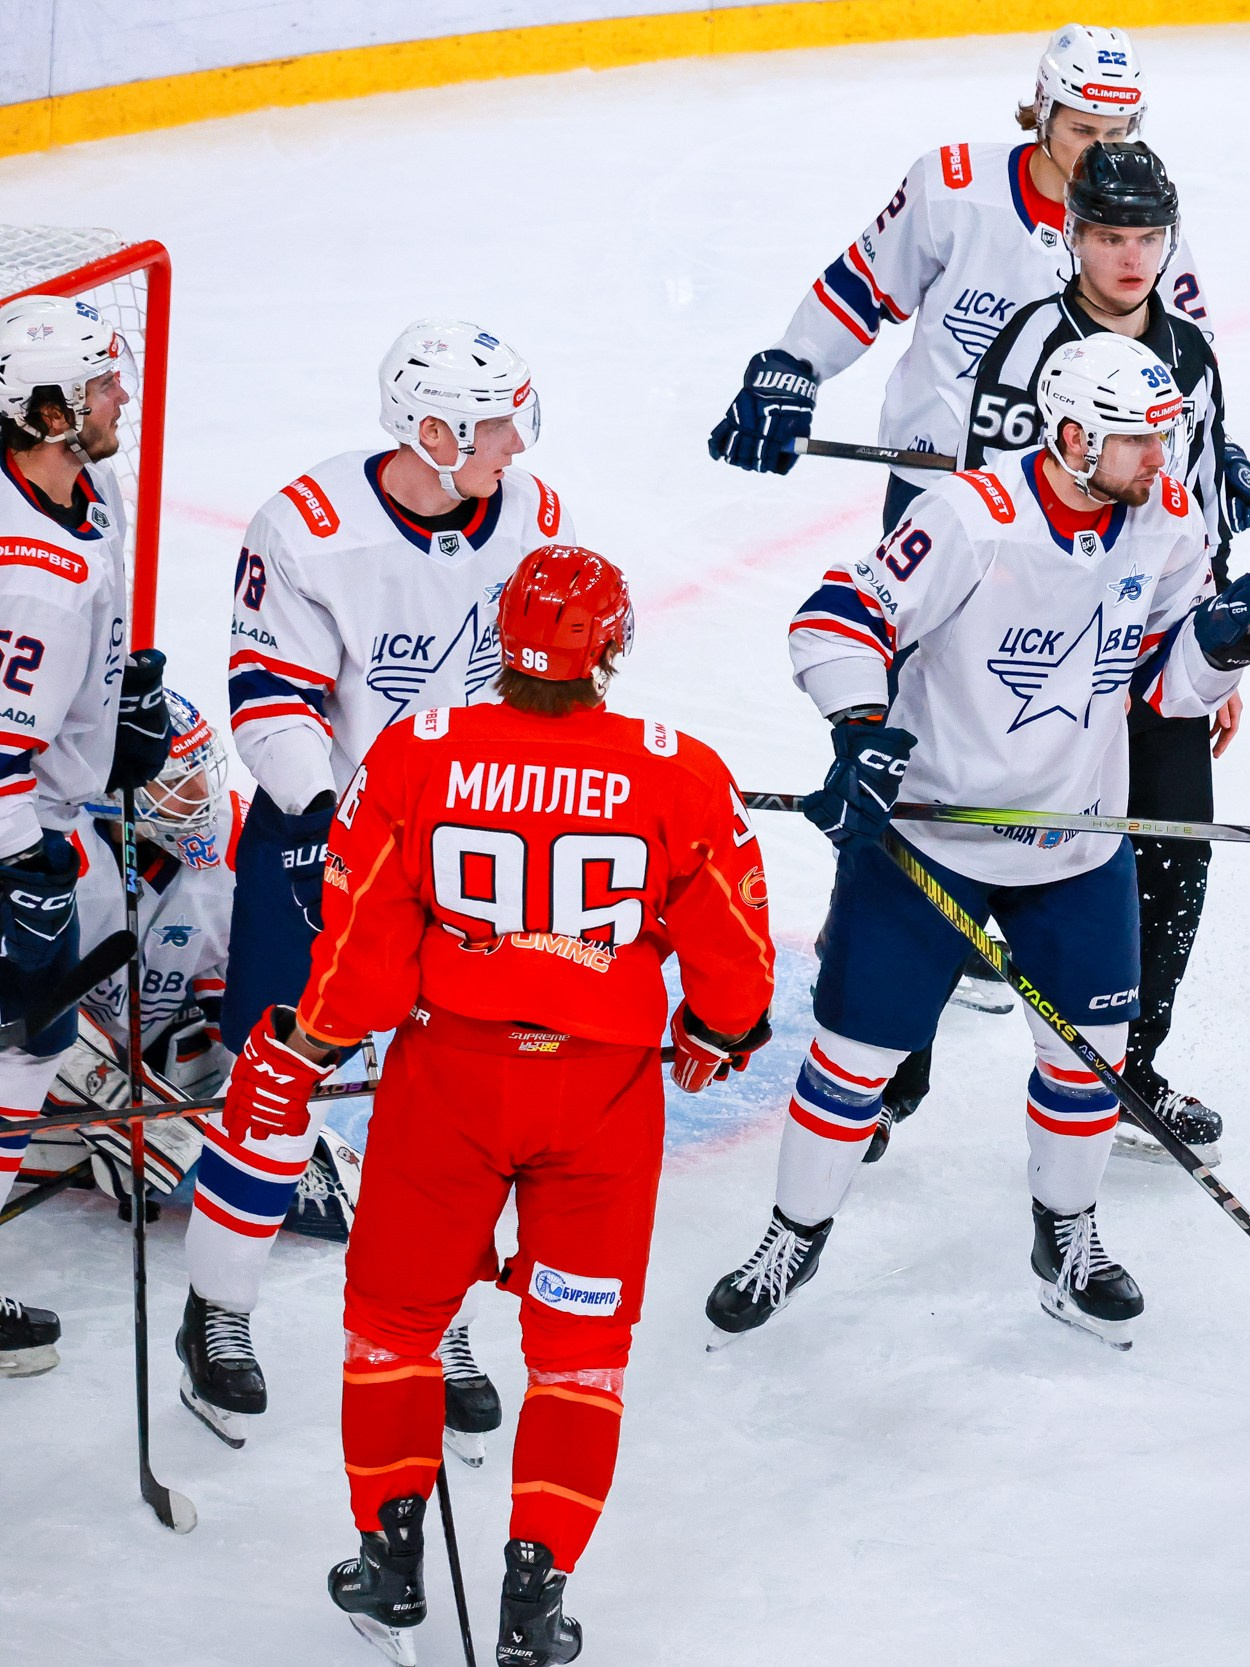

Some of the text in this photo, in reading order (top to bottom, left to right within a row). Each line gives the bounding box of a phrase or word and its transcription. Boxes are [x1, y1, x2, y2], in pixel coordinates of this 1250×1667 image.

[1097, 50, 1128, 67] 22
[1086, 86, 1138, 101] OLIMPBET
[953, 288, 1017, 323] ЦСК
[474, 332, 500, 351] 18
[1141, 364, 1172, 389] 39
[1052, 391, 1076, 406] CCM
[971, 393, 1036, 446] 56
[870, 580, 899, 616] LADA
[1231, 606, 1248, 615] CCM
[238, 621, 279, 650] LADA
[370, 633, 437, 664] ЦСК
[998, 628, 1065, 657] ЦСК
[521, 647, 549, 673] 96
[445, 760, 631, 820] МИЛЛЕР
[125, 821, 138, 895] CCM
[430, 822, 649, 947] 96
[1017, 975, 1078, 1042] TACKS
[1088, 984, 1140, 1011] CCM
[508, 1031, 571, 1042] SUPREME
[1102, 1069, 1118, 1085] PRO
[561, 1286, 617, 1306] БУРЭНЕРГО
